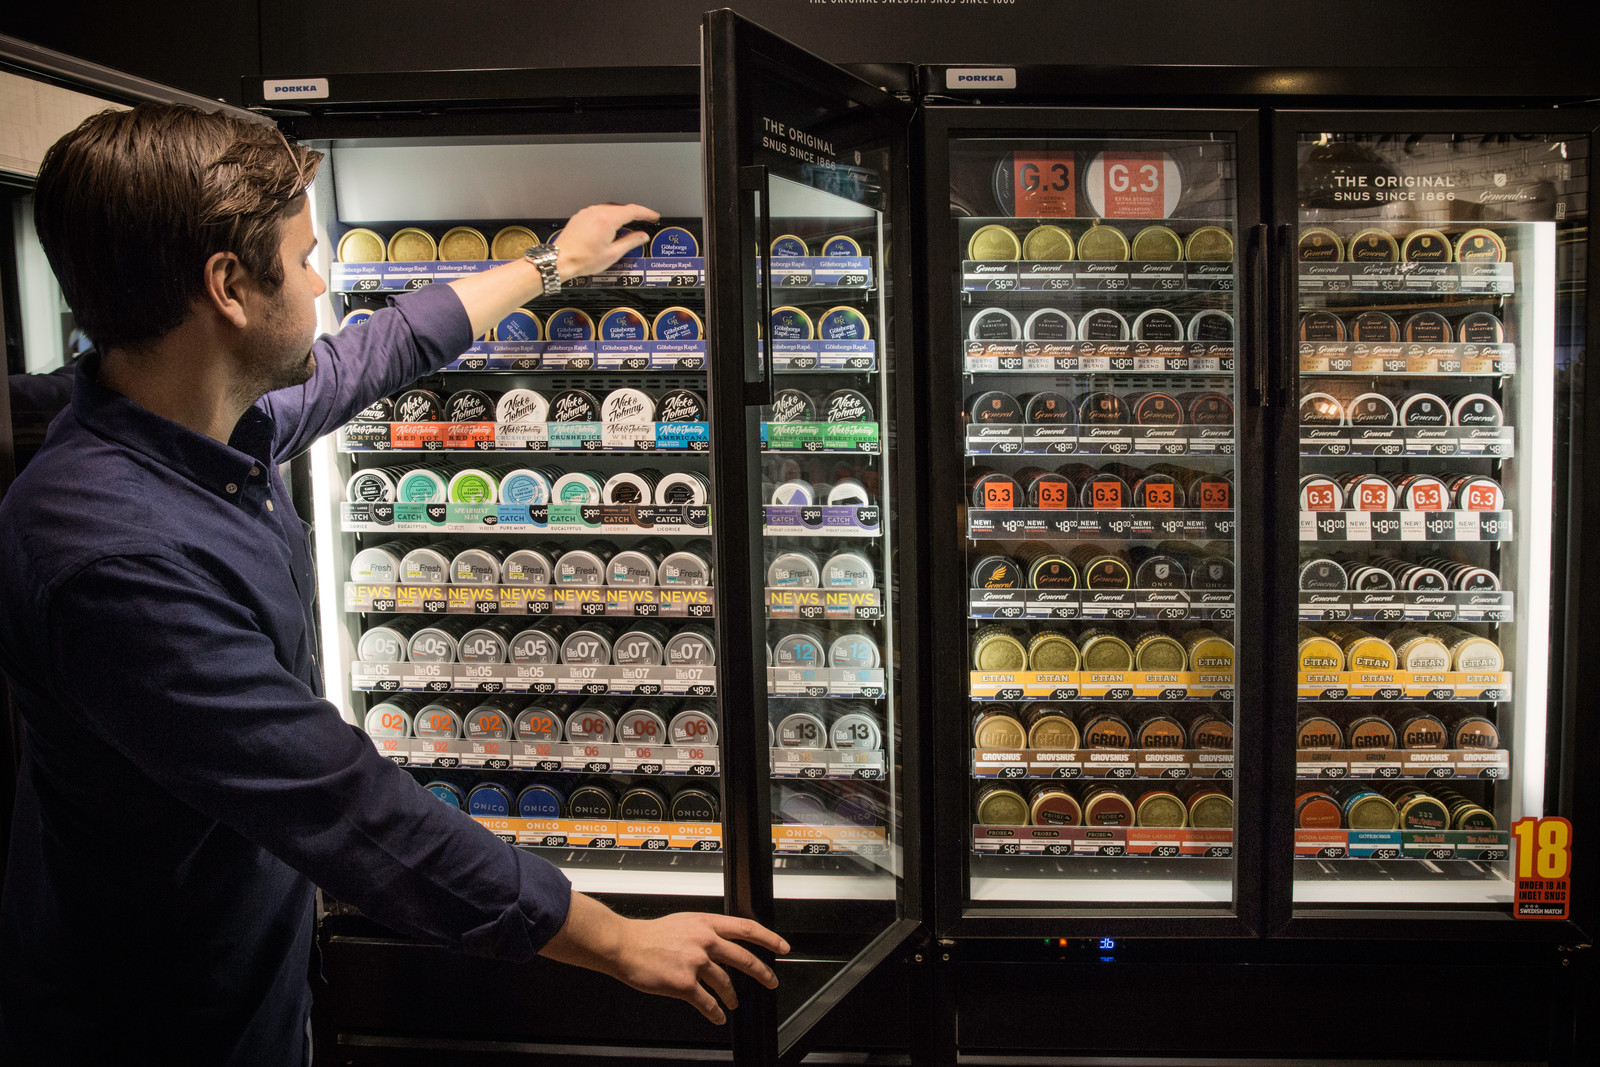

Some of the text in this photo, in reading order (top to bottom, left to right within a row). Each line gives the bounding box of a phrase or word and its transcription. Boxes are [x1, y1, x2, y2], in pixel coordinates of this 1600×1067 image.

[274, 85, 317, 93] PORKKA
[763, 116, 836, 157] THE ORIGINAL
[763, 137, 837, 171] SNUS SINCE 1866
[1019, 162, 1069, 192] G.3
[1109, 163, 1161, 193] G.3
[1334, 175, 1456, 187] THE ORIGINAL
[1334, 191, 1456, 201] SNUS SINCE 1866
[1479, 190, 1520, 204] General
[1411, 249, 1442, 258] General
[388, 265, 413, 273] Göteborgs
[973, 264, 1008, 273] General
[1028, 264, 1063, 273] General
[986, 343, 1019, 352] General
[610, 393, 633, 411] Nick
[662, 393, 682, 409] Nick
[609, 404, 644, 422] Johnny
[662, 404, 699, 422] Johnny
[1408, 413, 1443, 422] General
[1461, 413, 1496, 422] General
[979, 427, 1012, 436] General
[1144, 428, 1177, 437] General
[1308, 429, 1341, 438] General
[987, 488, 1011, 502] G.3
[1041, 488, 1064, 502] G.3
[1095, 488, 1118, 502] G.3
[1148, 490, 1172, 503] G.3
[1309, 490, 1333, 504] G.3
[1362, 490, 1386, 504] G.3
[1415, 490, 1439, 504] G.3
[1471, 491, 1494, 505] G.3
[397, 513, 422, 521] CATCH
[397, 587, 442, 599] NEWS
[448, 587, 493, 600] NEWS
[500, 588, 546, 600] NEWS
[553, 589, 600, 601] NEWS
[606, 589, 654, 602] NEWS
[660, 590, 708, 603] NEWS
[771, 592, 820, 605] NEWS
[826, 593, 875, 605] NEWS
[981, 592, 1015, 601] General
[1036, 592, 1069, 602] General
[1308, 594, 1341, 603] General
[1362, 594, 1395, 603] General
[424, 638, 447, 656] 05
[474, 639, 496, 655] 05
[526, 640, 547, 656] 05
[577, 642, 599, 657] 07
[627, 641, 649, 658] 07
[681, 643, 703, 659] 07
[793, 643, 814, 660] 12
[850, 642, 869, 660] 12
[1303, 658, 1337, 666] ETTAN
[1355, 657, 1390, 668] ETTAN
[1411, 659, 1444, 667] ETTAN
[982, 674, 1014, 682] ETTAN
[1036, 674, 1069, 682] ETTAN
[1146, 674, 1178, 682] ETTAN
[1307, 674, 1339, 682] ETTAN
[1361, 674, 1393, 682] ETTAN
[382, 713, 403, 730] 02
[430, 715, 452, 730] 02
[480, 715, 502, 731] 02
[530, 716, 552, 733] 02
[582, 717, 605, 734] 06
[633, 720, 657, 736] 06
[685, 720, 708, 737] 06
[796, 724, 816, 740] 13
[848, 723, 870, 740] 13
[1091, 732, 1127, 747] GROV
[1144, 734, 1180, 747] GROV
[1301, 734, 1336, 747] GROV
[1355, 734, 1390, 748] GROV
[1407, 731, 1442, 745] GROV
[982, 753, 1021, 761] GROVSNUS
[473, 802, 505, 812] ONICO
[574, 824, 608, 832] ONICO
[627, 825, 661, 833] ONICO
[678, 826, 712, 834] ONICO
[786, 829, 822, 838] ONICO
[1515, 820, 1568, 879] 18
[1519, 881, 1544, 890] UNDER
[1546, 881, 1554, 890] 18
[1519, 891, 1566, 900] INGET SNUS
